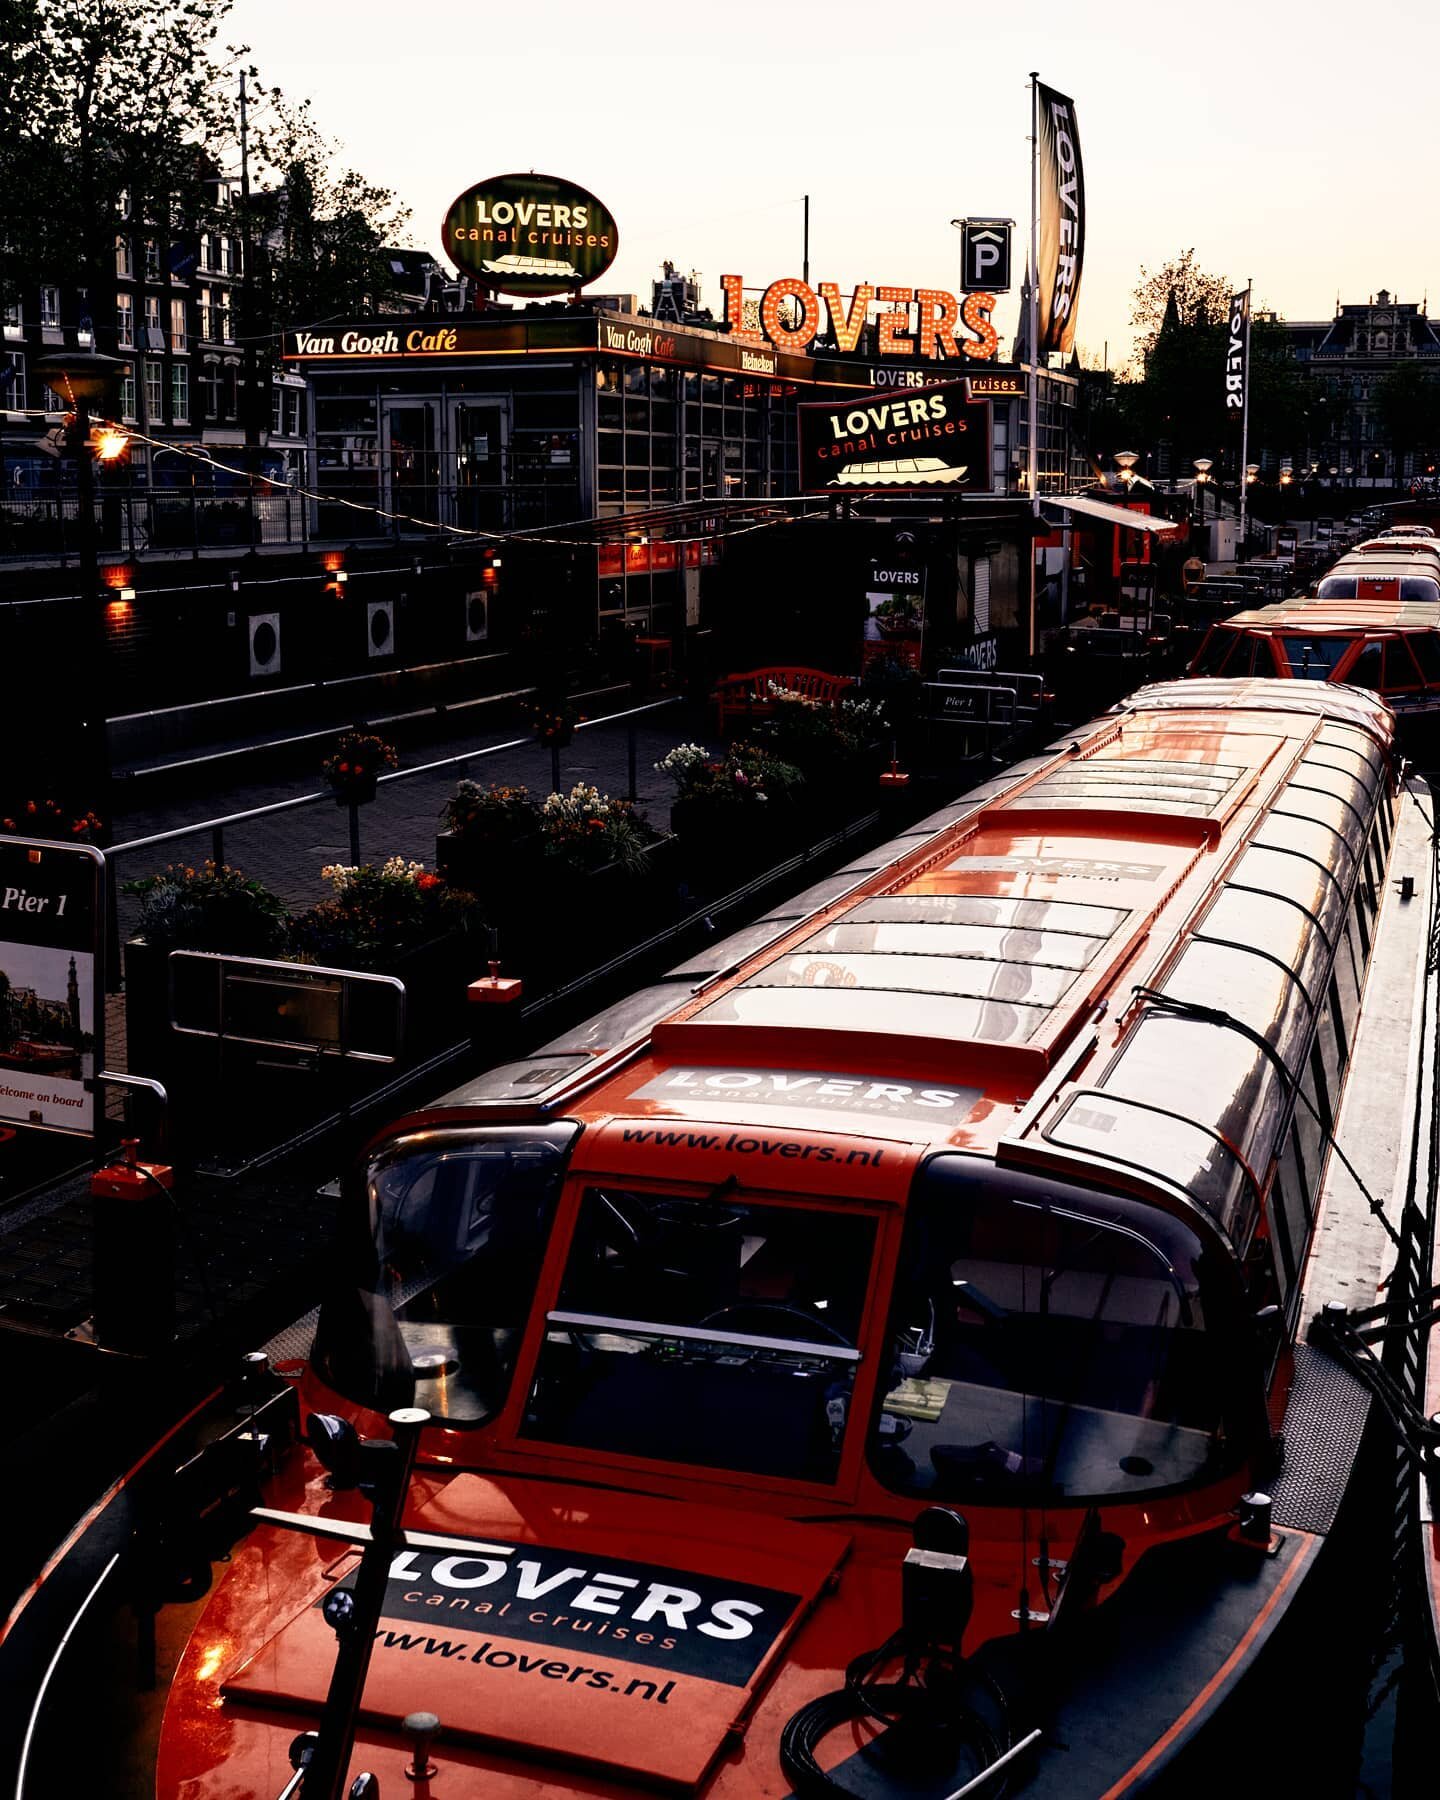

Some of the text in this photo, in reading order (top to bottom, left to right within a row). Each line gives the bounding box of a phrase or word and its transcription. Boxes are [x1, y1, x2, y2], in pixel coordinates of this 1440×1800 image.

[477, 201, 588, 229] LOVERS
[1051, 102, 1078, 320] LOVERS
[455, 227, 609, 247] canal cruises
[975, 244, 1000, 279] P
[720, 275, 998, 360] LOVERS
[295, 329, 457, 355] Van Gogh Café
[606, 326, 676, 357] Van Gogh Café
[742, 351, 774, 373] Heineken
[870, 369, 924, 388] LOVERS
[972, 378, 1017, 391] ruises
[830, 395, 948, 439] LOVERS
[817, 419, 968, 458] canal cruises
[873, 570, 920, 584] LOVERS
[1000, 857, 1151, 874] OVERS
[2, 887, 68, 916] Pier 1
[0, 1085, 84, 1108] elcome on board
[666, 1071, 962, 1108] LOVERS
[689, 1088, 772, 1098] canal
[623, 1128, 885, 1168] www.lovers.nl
[388, 1550, 765, 1641] LOVERS
[403, 1590, 678, 1651] canal cruises
[374, 1630, 678, 1705] ww.lovers.nl
